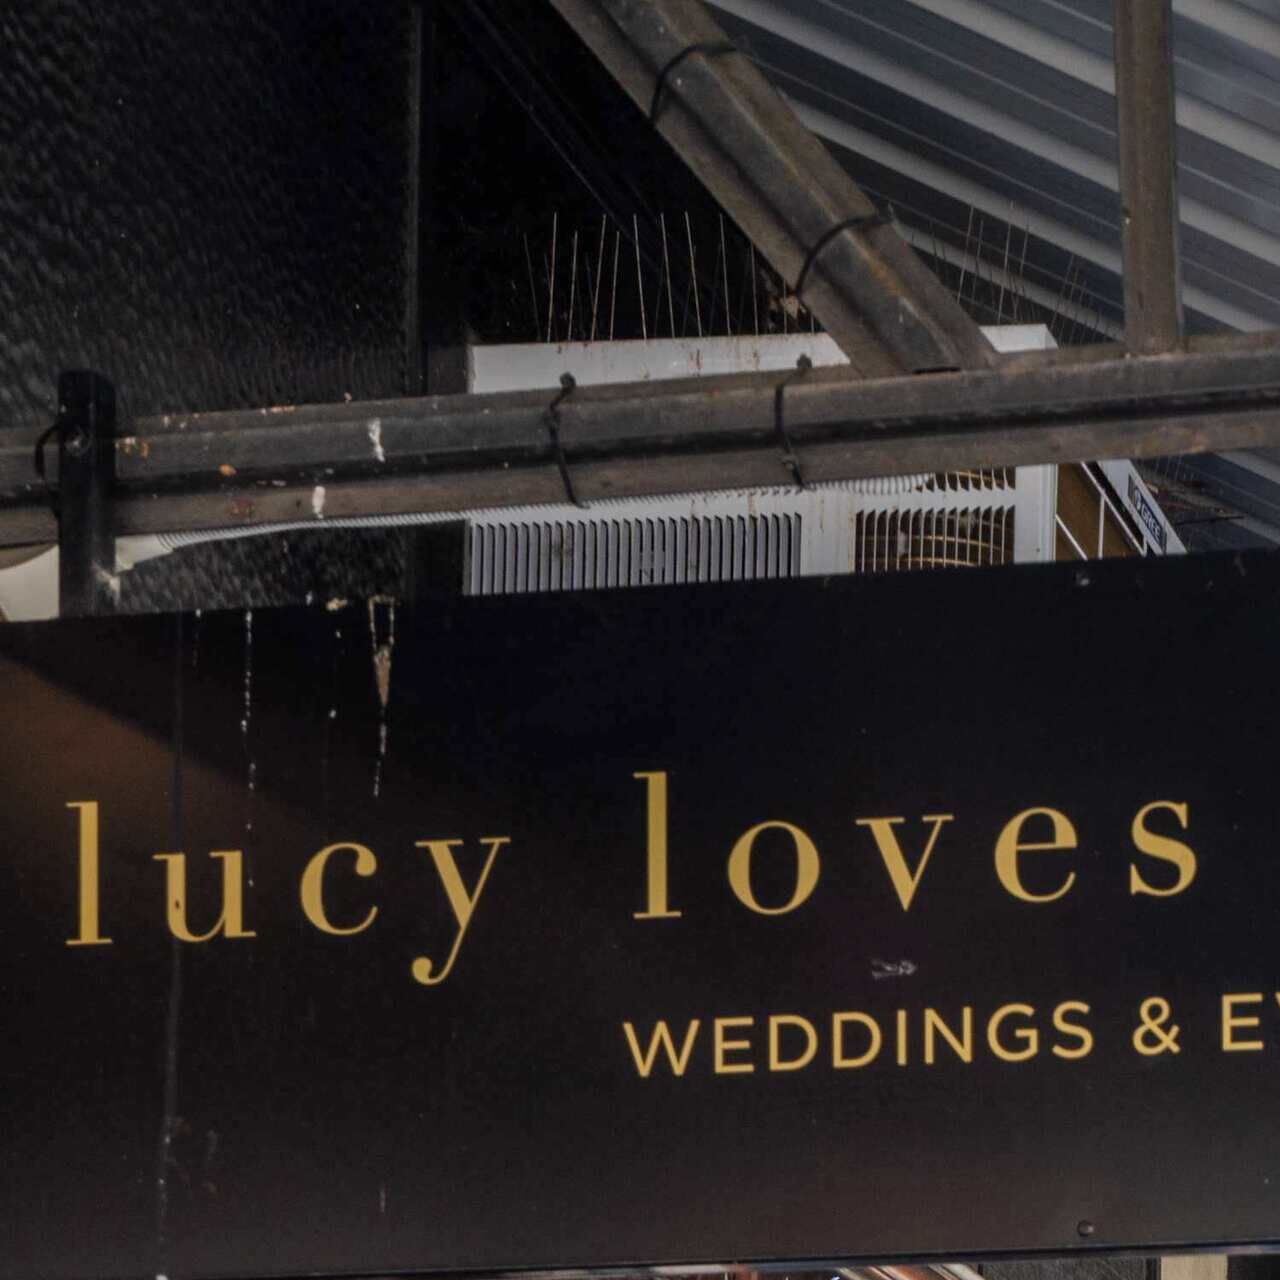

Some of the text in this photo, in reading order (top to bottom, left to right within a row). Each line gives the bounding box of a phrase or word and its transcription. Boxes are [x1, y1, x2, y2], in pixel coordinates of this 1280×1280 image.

[64, 800, 512, 985] lucy
[632, 771, 1199, 920] loves
[622, 999, 1094, 1078] WEDDINGS
[1132, 996, 1181, 1057] &
